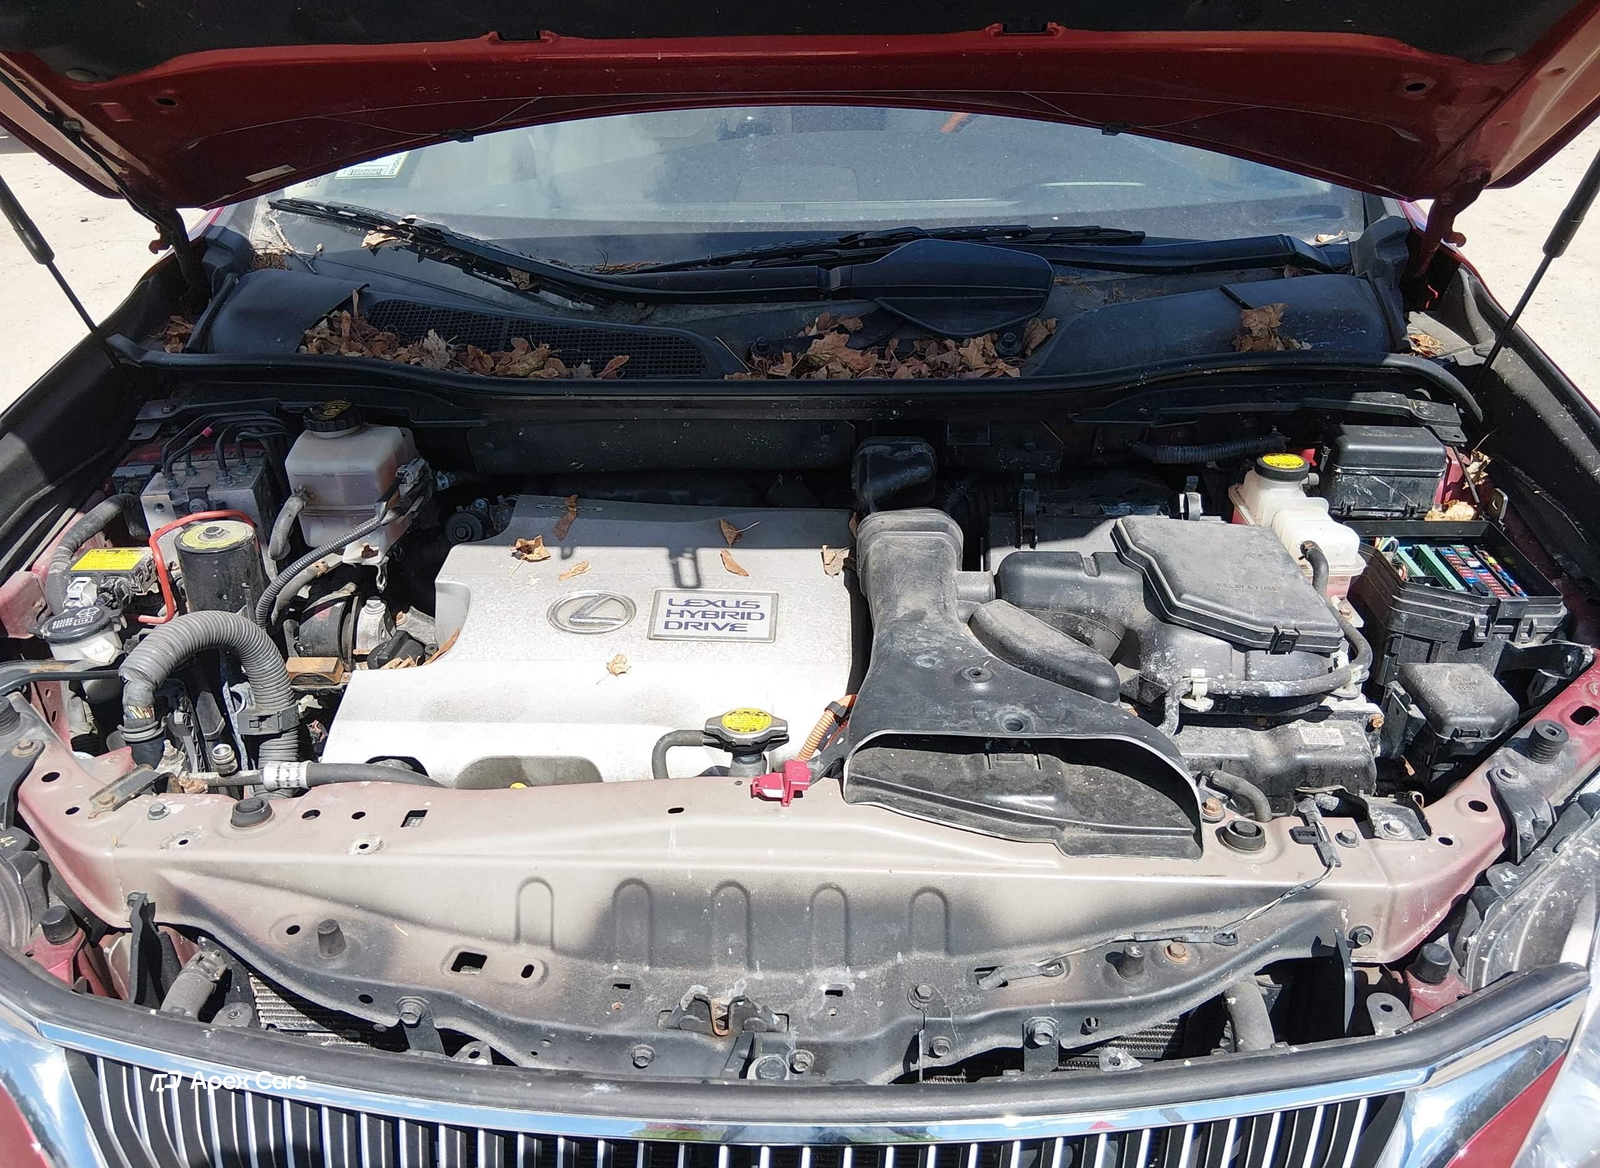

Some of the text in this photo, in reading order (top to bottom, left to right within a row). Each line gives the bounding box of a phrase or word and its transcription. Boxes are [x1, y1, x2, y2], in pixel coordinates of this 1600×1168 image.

[667, 598, 761, 609] LEXUS
[665, 609, 766, 621] HYBRID
[663, 620, 749, 632] DRIVE
